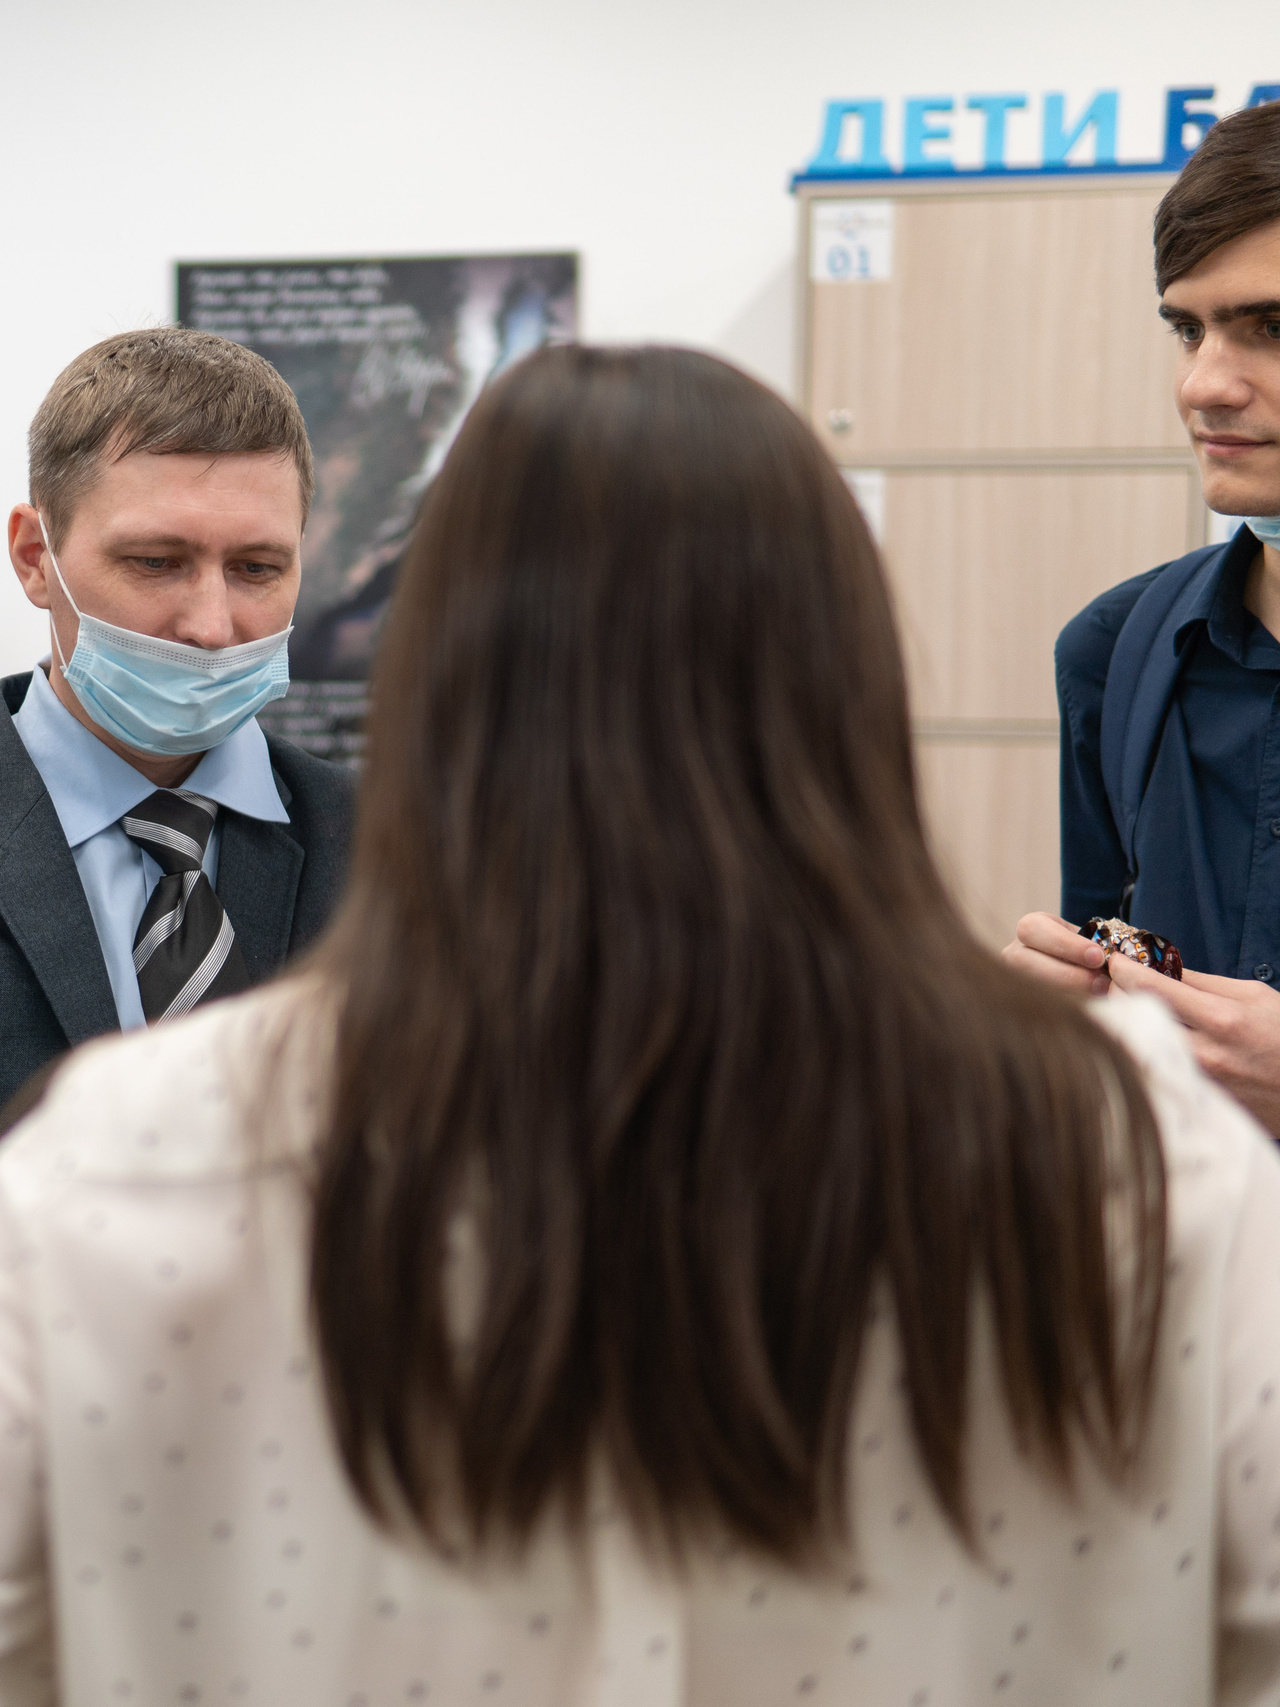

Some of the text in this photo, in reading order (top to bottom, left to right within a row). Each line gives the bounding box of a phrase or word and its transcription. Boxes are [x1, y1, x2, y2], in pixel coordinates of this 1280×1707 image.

[803, 84, 1280, 174] ДЕТИ Б
[827, 245, 872, 280] 01
